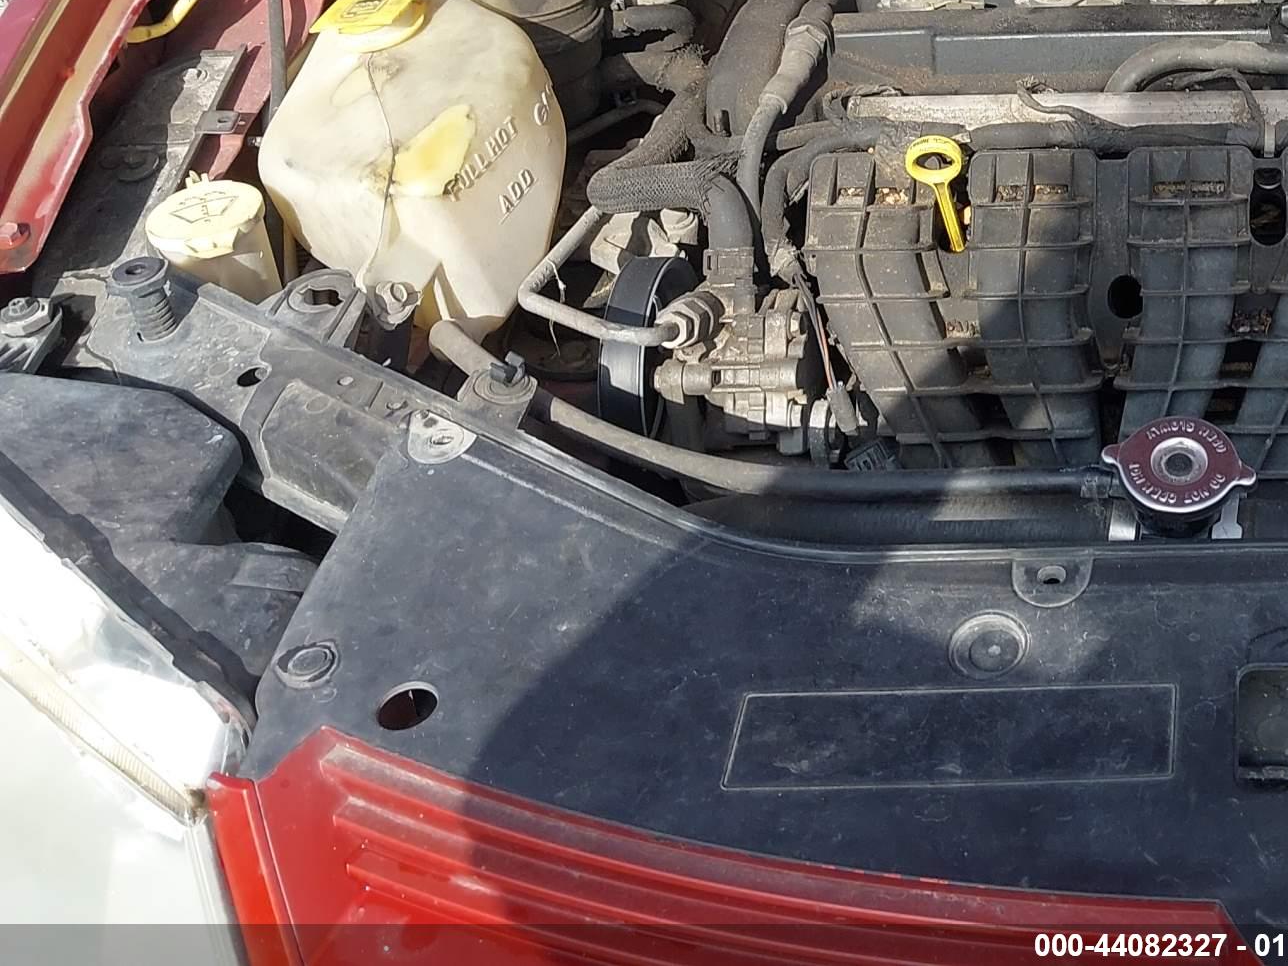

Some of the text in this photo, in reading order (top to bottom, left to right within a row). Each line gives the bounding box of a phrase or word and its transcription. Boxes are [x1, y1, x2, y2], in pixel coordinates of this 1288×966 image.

[447, 114, 518, 203] FULL HOT
[499, 168, 535, 214] ADD
[1209, 473, 1226, 490] DO
[1142, 482, 1177, 504] OPEN
[1183, 488, 1210, 504] NOT
